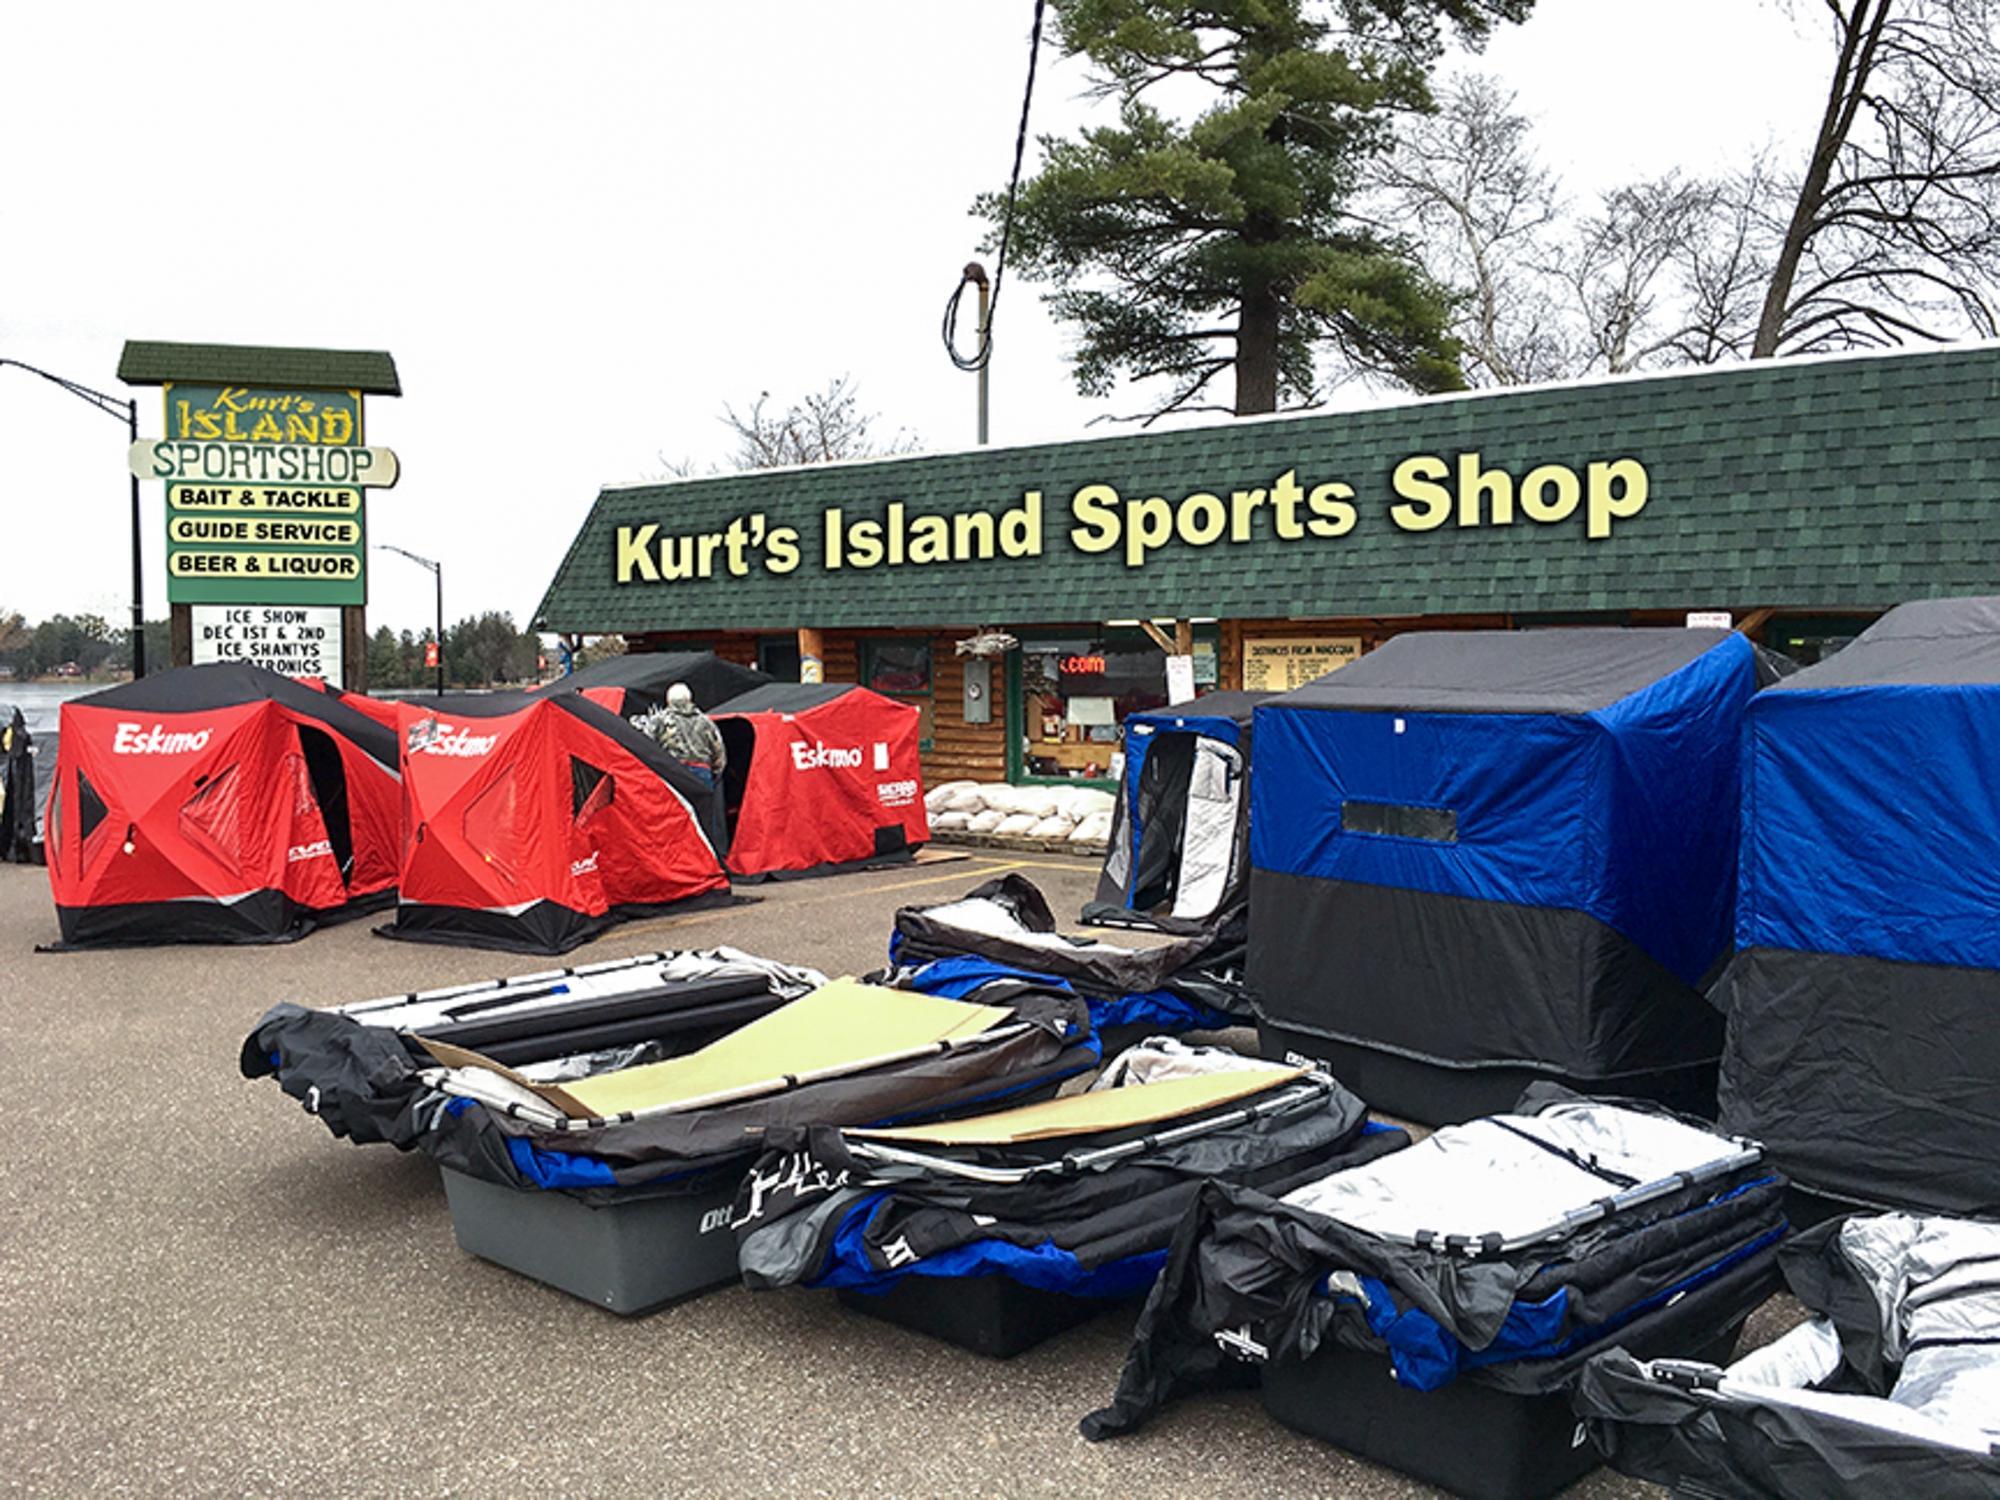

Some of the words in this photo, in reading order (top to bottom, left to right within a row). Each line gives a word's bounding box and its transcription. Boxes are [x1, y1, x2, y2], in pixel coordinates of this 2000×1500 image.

[213, 386, 315, 413] Kurt's
[177, 400, 353, 444] ISLAND
[152, 442, 373, 482] SPORTSHOP
[180, 489, 232, 506] BAIT
[239, 490, 255, 506] &
[263, 490, 351, 508] TACKLE
[617, 513, 800, 583] Kurt's
[825, 491, 1042, 568] Island
[1071, 470, 1357, 566] Sports
[1391, 453, 1649, 539] Shop
[178, 521, 248, 539] GUIDE
[255, 523, 352, 541] SERVICE
[178, 556, 237, 572] BEER
[245, 557, 260, 573] &
[269, 557, 355, 574] LIQUOR
[226, 609, 252, 623] ICE
[263, 609, 307, 624] SHOW
[203, 626, 234, 640] DEC
[277, 627, 287, 640] &
[298, 627, 325, 640] 2ND
[217, 643, 242, 656] ICE
[250, 643, 321, 657] SHANTYS
[218, 657, 322, 673] TRONICS
[113, 722, 210, 754] Eskimo
[790, 740, 863, 770] Eskimo
